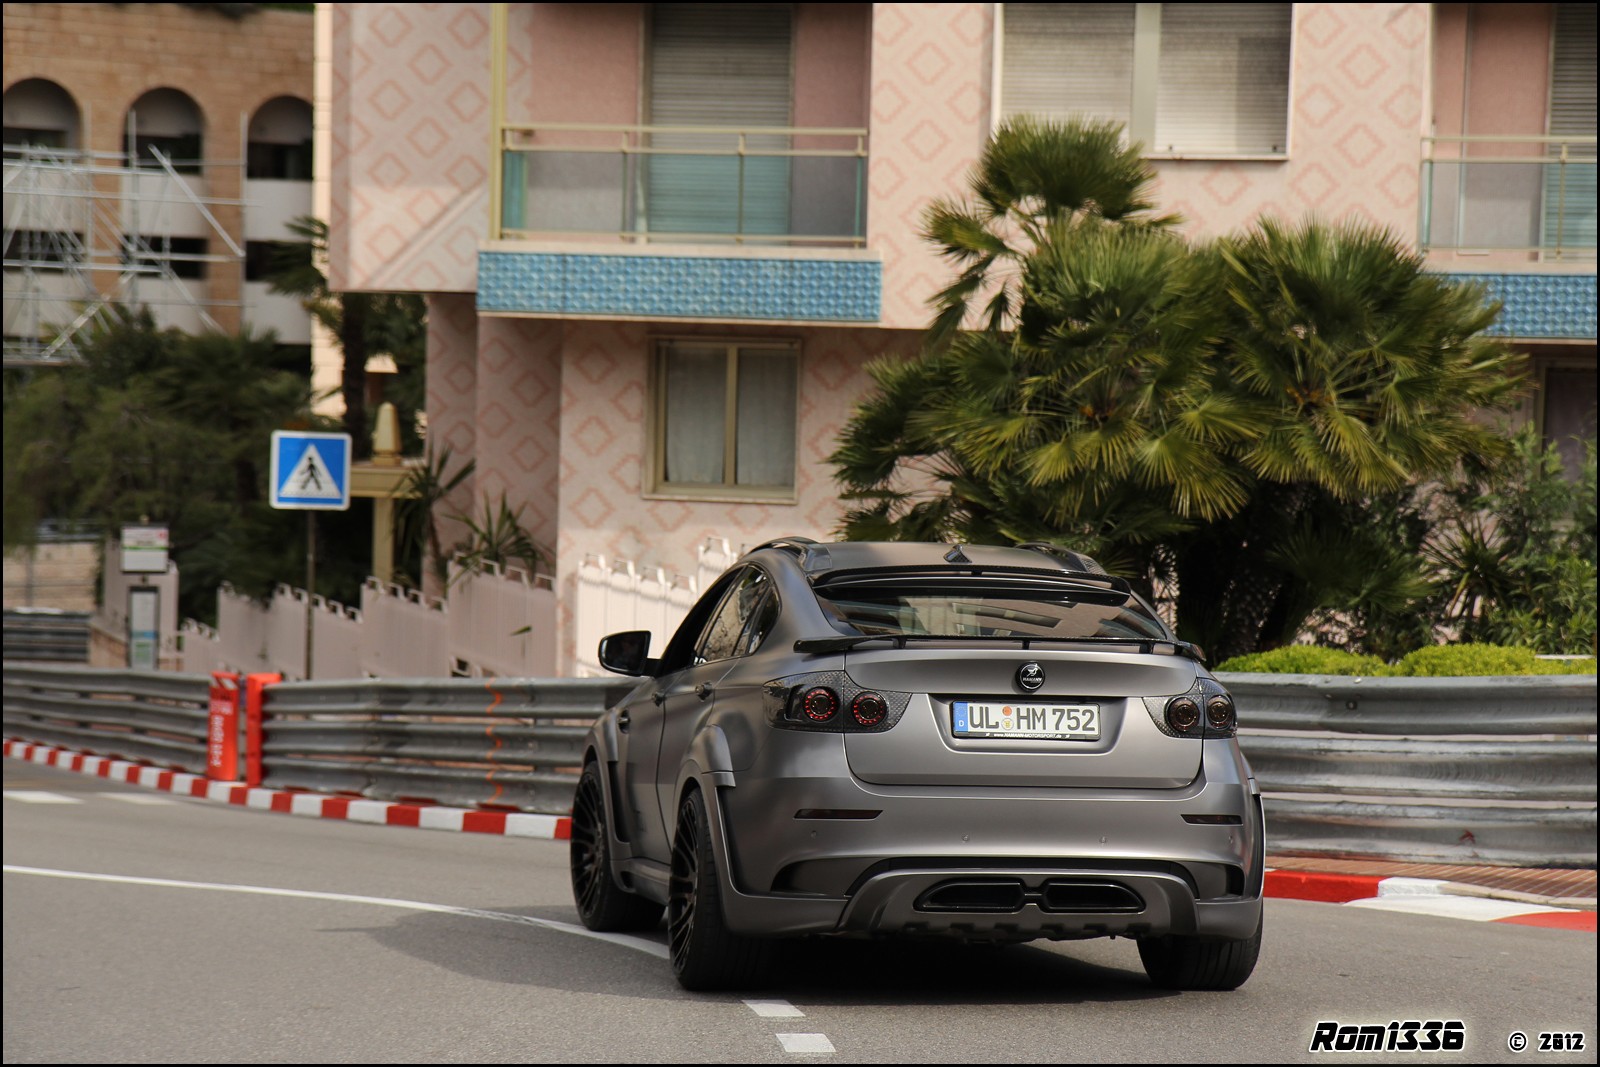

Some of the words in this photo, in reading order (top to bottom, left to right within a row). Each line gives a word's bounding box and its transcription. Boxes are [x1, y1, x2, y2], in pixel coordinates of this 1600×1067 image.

[969, 706, 999, 729] UL
[1016, 708, 1046, 730] HM
[1052, 709, 1095, 731] 752
